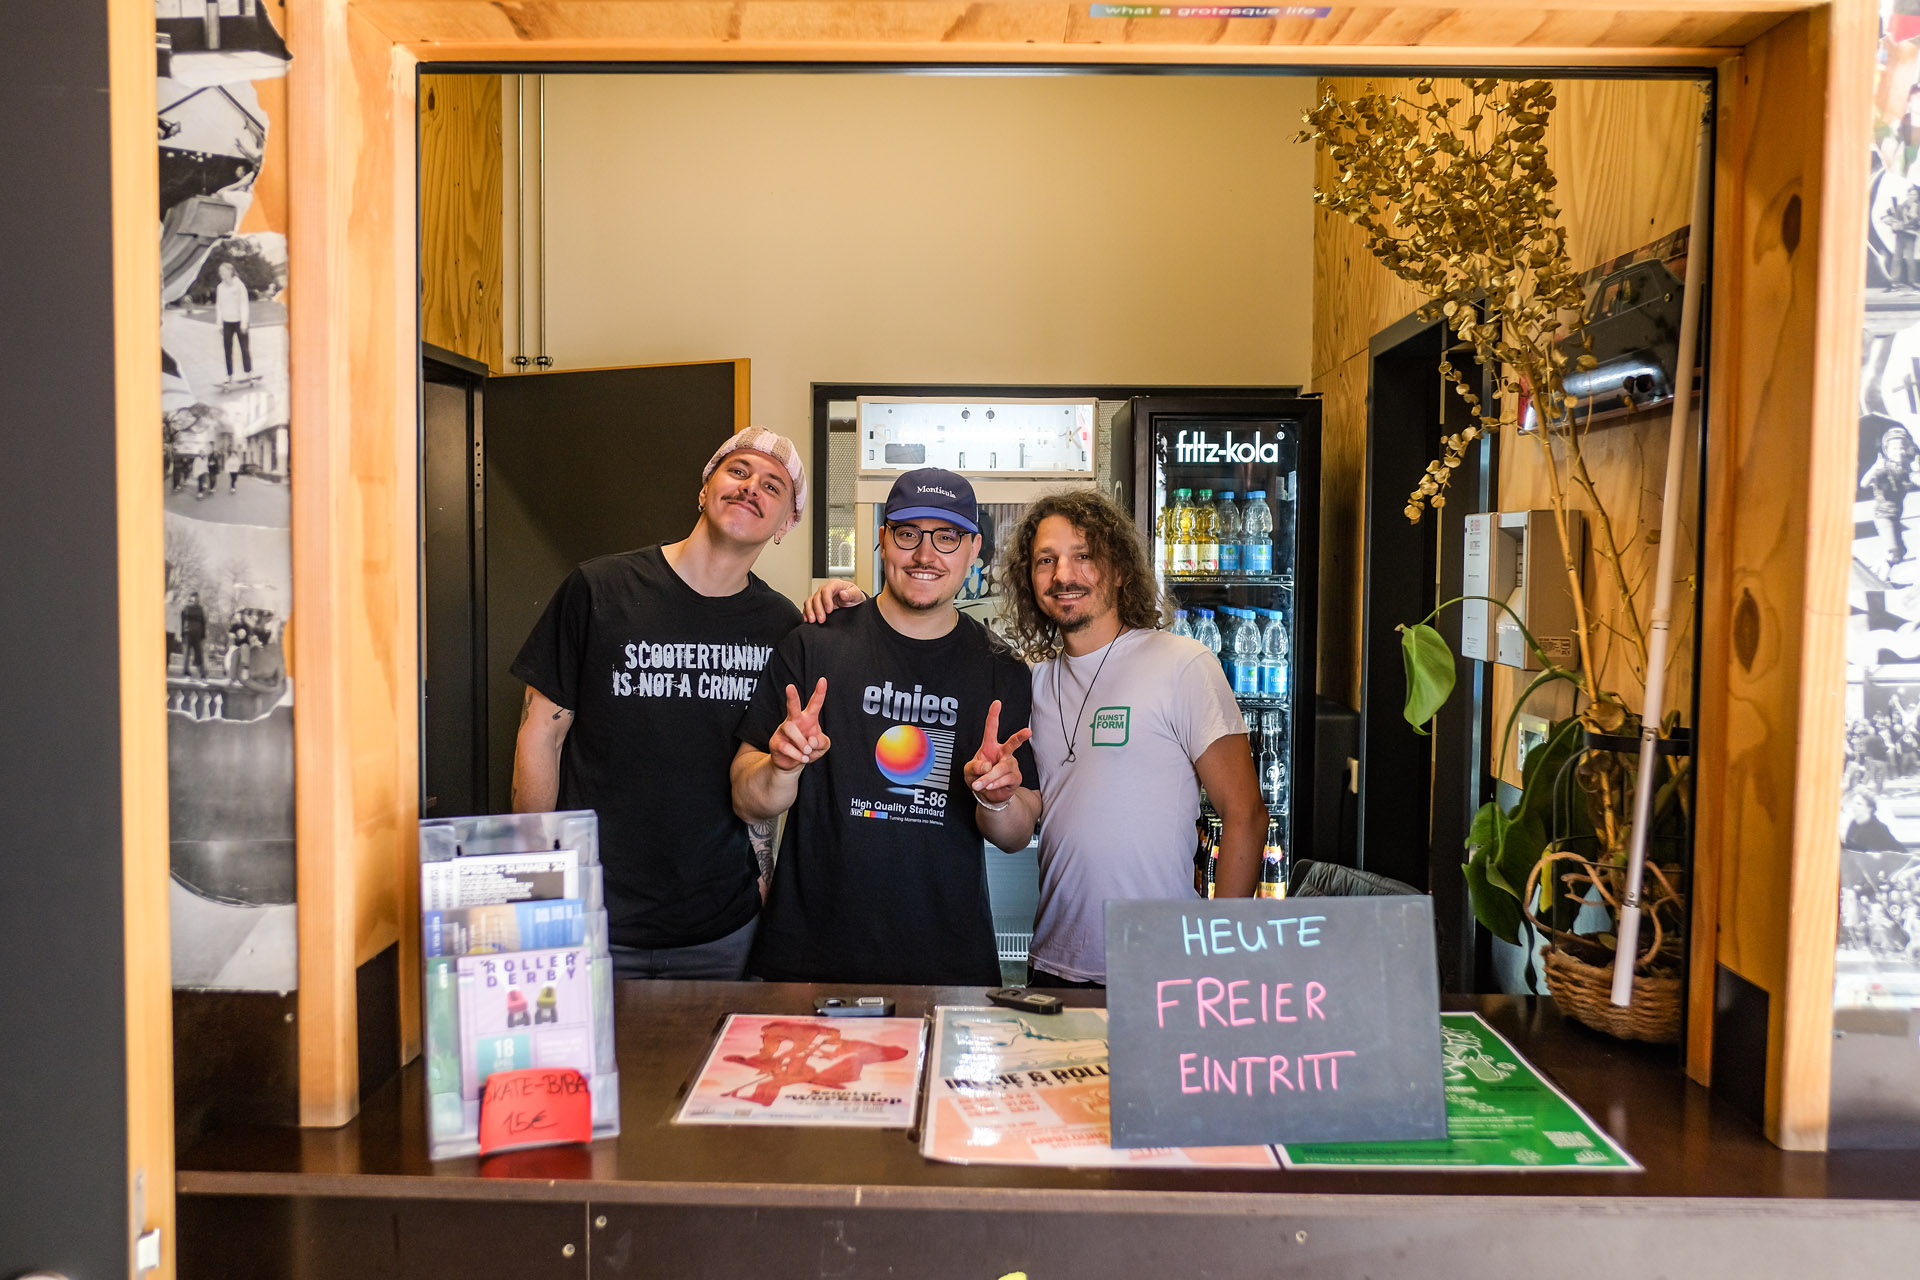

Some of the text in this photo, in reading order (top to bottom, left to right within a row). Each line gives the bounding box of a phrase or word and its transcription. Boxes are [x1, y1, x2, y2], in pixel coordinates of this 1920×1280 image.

[1104, 5, 1317, 18] what a grotesque life
[612, 671, 632, 697] IS
[639, 672, 674, 698] NOT
[679, 673, 692, 698] A
[862, 680, 959, 727] etnies
[1096, 720, 1125, 729] FORM
[851, 797, 945, 818] High Quality Standard
[913, 787, 948, 808] E-86
[1181, 914, 1327, 956] HEUTE
[486, 953, 577, 974] ROLLER
[486, 967, 576, 988] DERBY
[1157, 976, 1327, 1028] FREIER
[493, 1038, 515, 1059] 18
[1179, 1050, 1356, 1096] EINTRITT
